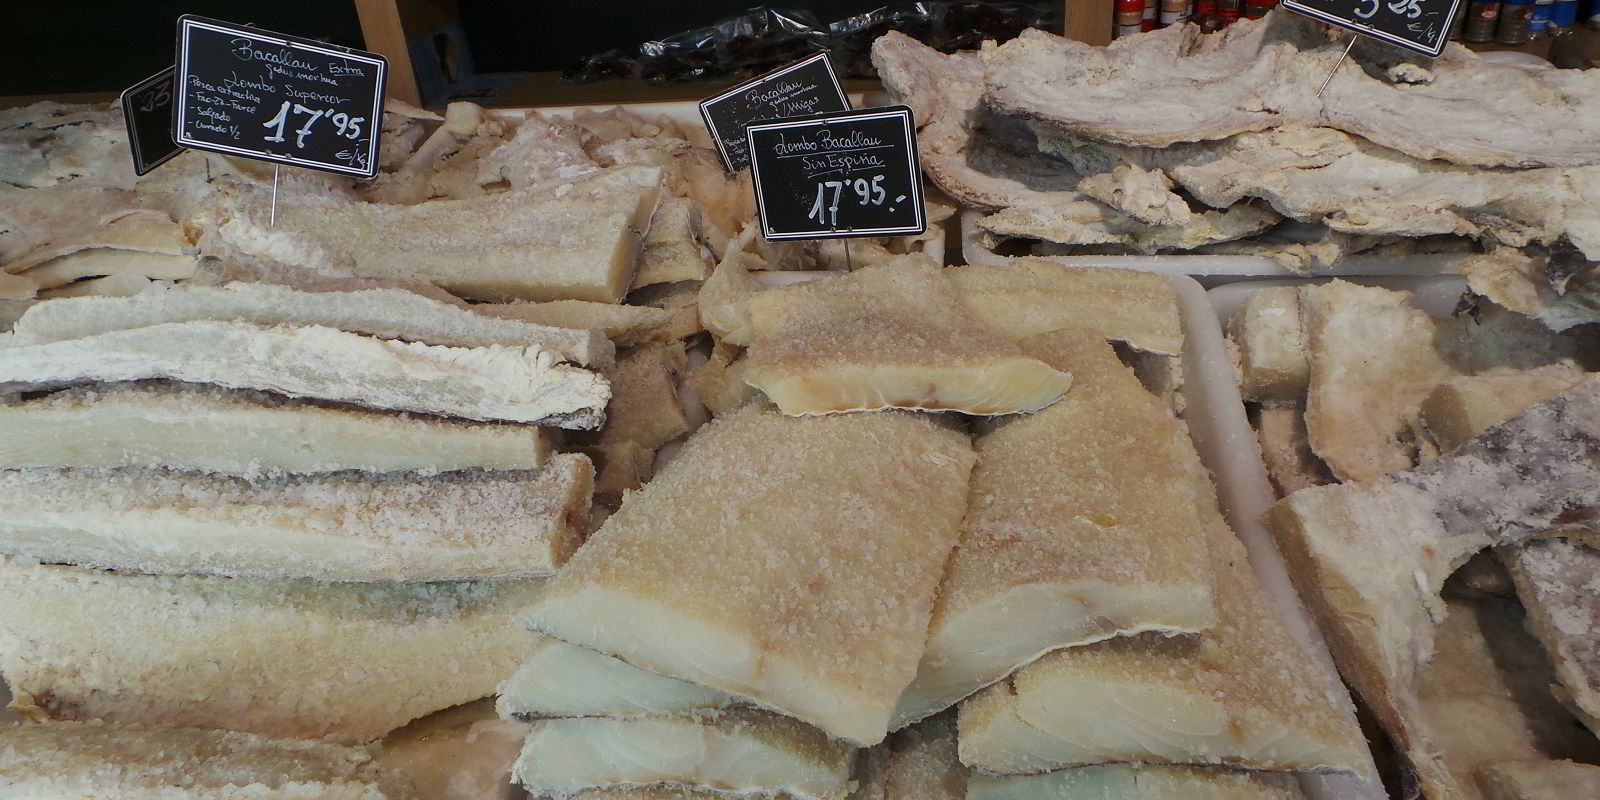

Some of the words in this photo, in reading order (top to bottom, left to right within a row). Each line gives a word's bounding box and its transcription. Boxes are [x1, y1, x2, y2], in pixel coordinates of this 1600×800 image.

[231, 38, 317, 71] Bacallau
[329, 59, 364, 77] Extra
[224, 71, 276, 93] Lombo
[265, 64, 293, 79] gadus
[296, 73, 338, 86] morhua
[745, 81, 802, 109] Bacallau
[197, 106, 231, 124] Salgado
[195, 120, 228, 133] Curado
[774, 132, 817, 155] Lombo
[816, 129, 882, 150] Bacallau
[802, 156, 827, 170] Sin
